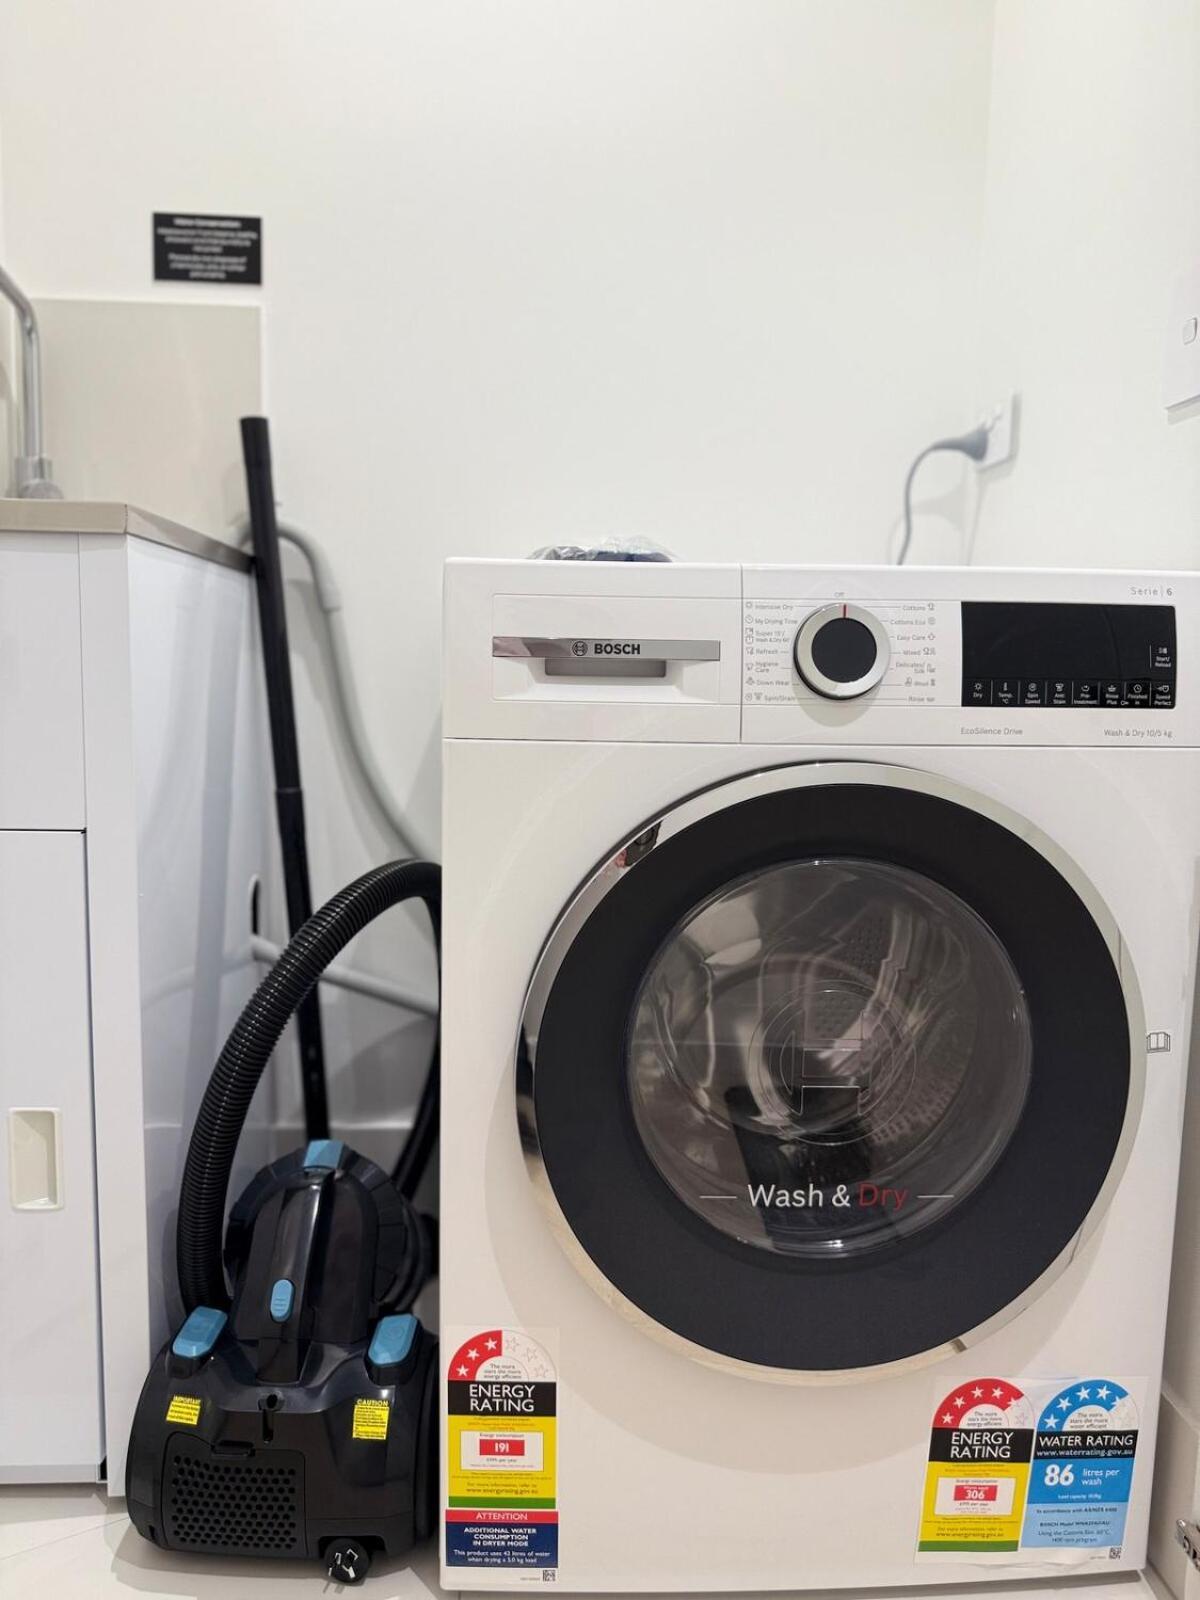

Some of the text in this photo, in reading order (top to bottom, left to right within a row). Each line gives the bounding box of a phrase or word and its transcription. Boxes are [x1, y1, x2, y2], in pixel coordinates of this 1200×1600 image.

[1130, 586, 1172, 596] Serie 6
[896, 634, 911, 642] Easy
[594, 643, 641, 655] BOSCH
[961, 727, 1002, 735] EcoSilence
[1132, 730, 1144, 738] Dry
[1146, 729, 1162, 737] 10/5
[1164, 730, 1173, 738] kg
[748, 1183, 908, 1212] Wash & Dry
[469, 1384, 535, 1398] ENERGY
[470, 1399, 535, 1412] RATING
[951, 1432, 1014, 1445] ENERGY
[1039, 1435, 1134, 1447] WATER RATING
[495, 1443, 509, 1453] 191
[950, 1446, 1011, 1459] RATING
[1036, 1449, 1133, 1457] www.waterrating.gov.au
[1044, 1464, 1074, 1486] 86
[1105, 1469, 1120, 1479] per
[1081, 1478, 1102, 1486] wash
[965, 1490, 985, 1499] 306
[476, 1512, 528, 1520] ATTENTION
